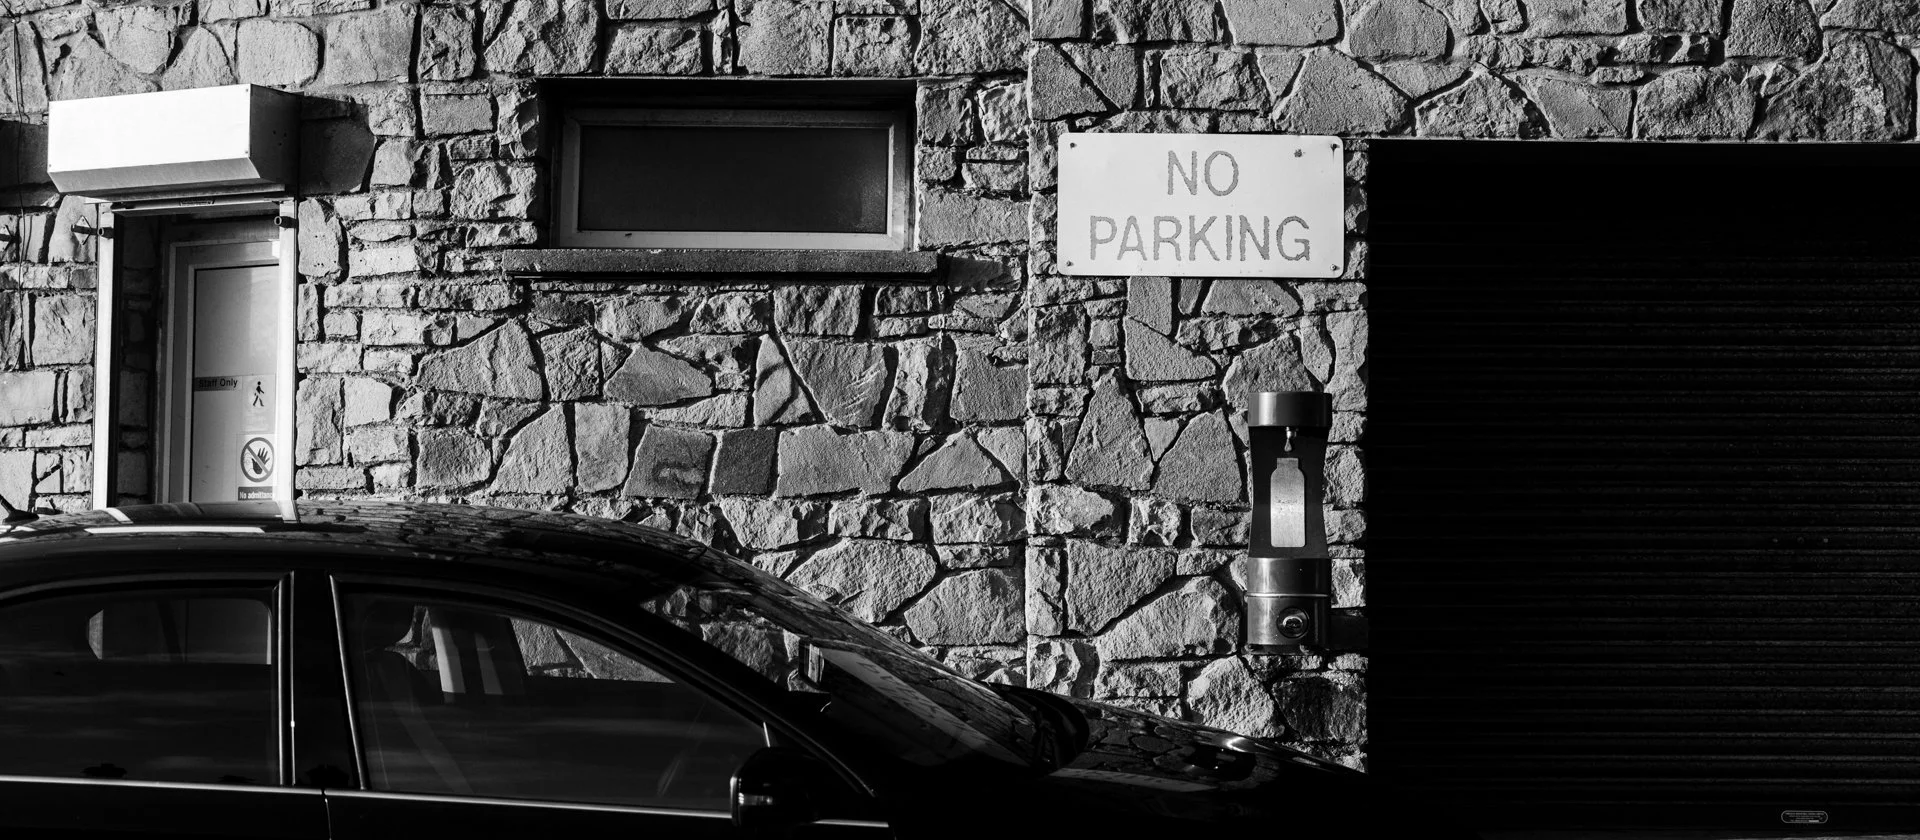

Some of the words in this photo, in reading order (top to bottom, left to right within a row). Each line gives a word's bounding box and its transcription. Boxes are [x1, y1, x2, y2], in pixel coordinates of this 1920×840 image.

[1167, 150, 1240, 196] NO
[1089, 215, 1311, 262] PARKING
[199, 379, 217, 388] Staff
[220, 378, 238, 388] Only
[239, 491, 247, 499] No
